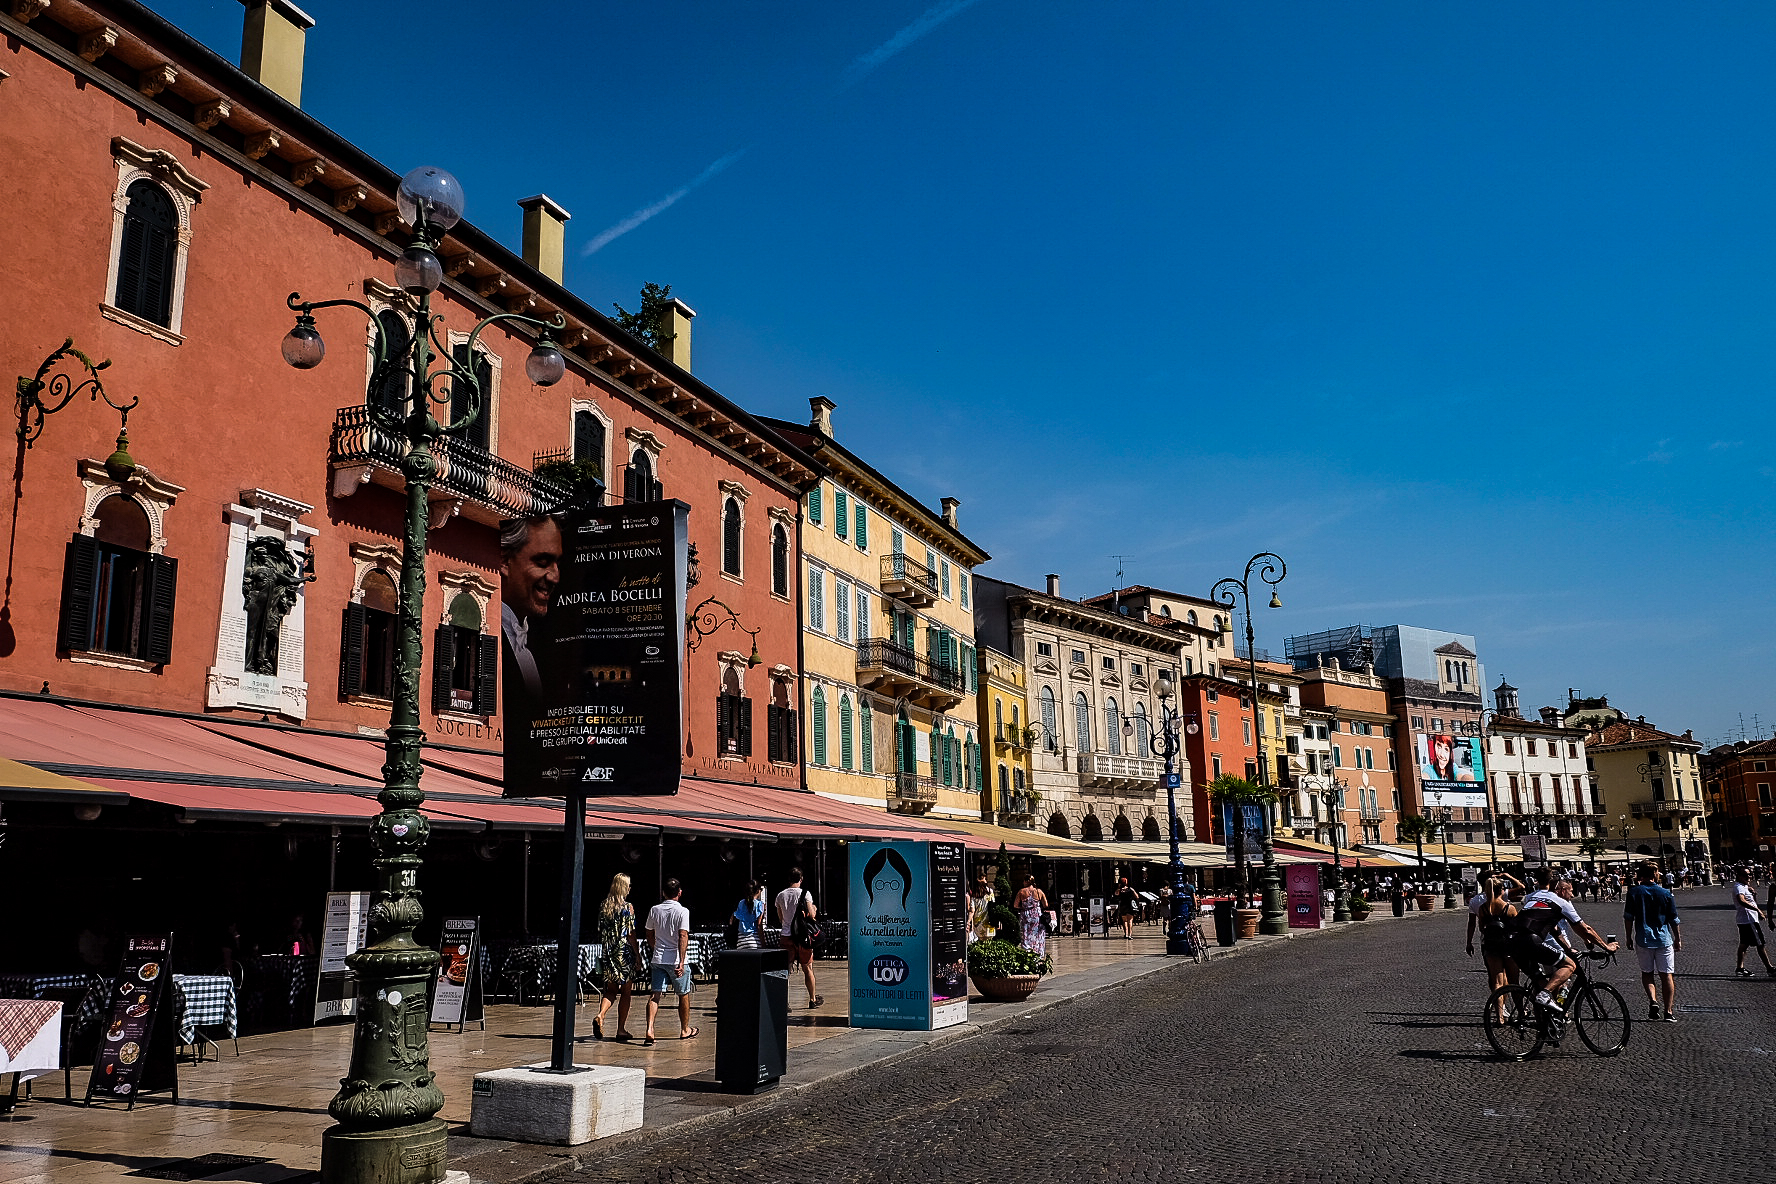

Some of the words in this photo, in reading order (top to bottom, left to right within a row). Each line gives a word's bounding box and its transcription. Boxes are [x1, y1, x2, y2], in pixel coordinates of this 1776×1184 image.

[574, 552, 606, 564] ARENA
[609, 550, 620, 560] DI
[622, 546, 662, 559] VERONA
[629, 576, 650, 587] notte
[556, 592, 606, 606] ANDREA
[611, 588, 662, 602] BOCELLI
[582, 606, 614, 616] SABATO
[622, 604, 662, 614] SETTEMBRE
[626, 614, 642, 622] ORE
[642, 613, 662, 622] 20.30
[548, 708, 562, 717] INFO
[564, 708, 568, 716] E
[568, 706, 608, 715] BIGLIETTI
[610, 705, 624, 714] SU
[578, 716, 584, 724] E
[586, 716, 644, 724] GETICKET.IT
[530, 730, 534, 738] E
[536, 728, 562, 738] PRESSO
[562, 726, 568, 736] LE
[570, 726, 598, 735] FILIALI
[600, 726, 646, 734] ABILITATE
[542, 738, 554, 748] DEL
[556, 736, 584, 746] GRUPPO
[596, 736, 628, 745] UniCredit
[702, 756, 732, 771] VIAGGI
[748, 762, 794, 778] VALPANTENA
[447, 920, 467, 928] BREK
[878, 914, 910, 926] differenza
[860, 926, 872, 936] sta
[874, 926, 896, 936] nella
[896, 926, 918, 936] lente
[874, 967, 904, 982] LOV
[853, 988, 896, 1000] COSTRUTTORI
[898, 990, 904, 1000] DI
[906, 990, 925, 1000] LENTI
[326, 1000, 350, 1012] BREK
